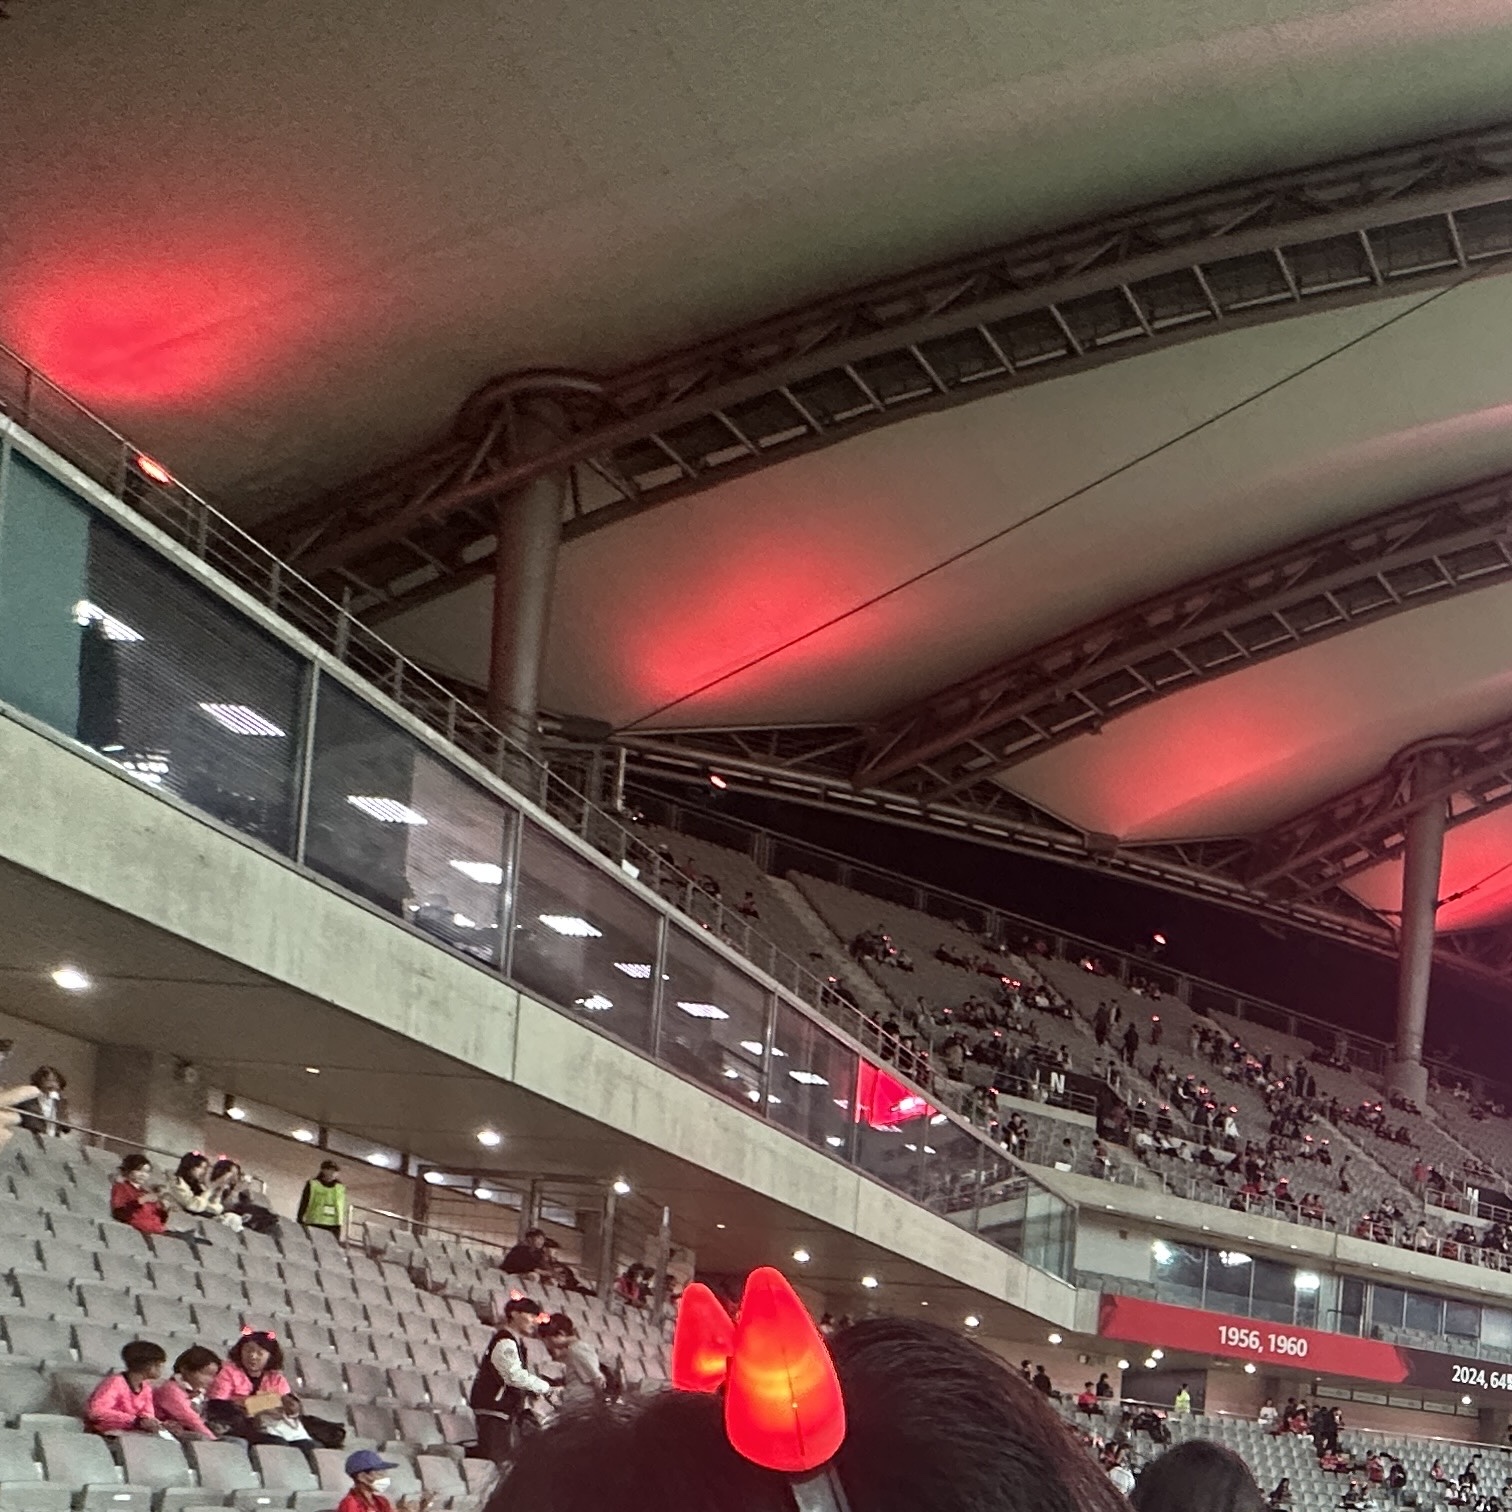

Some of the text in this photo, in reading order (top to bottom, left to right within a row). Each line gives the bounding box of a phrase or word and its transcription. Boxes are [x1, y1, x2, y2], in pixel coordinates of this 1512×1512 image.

[1051, 1072, 1065, 1093] N
[1218, 1325, 1308, 1357] 1956, 1960
[1452, 1365, 1489, 1390] 2024,
